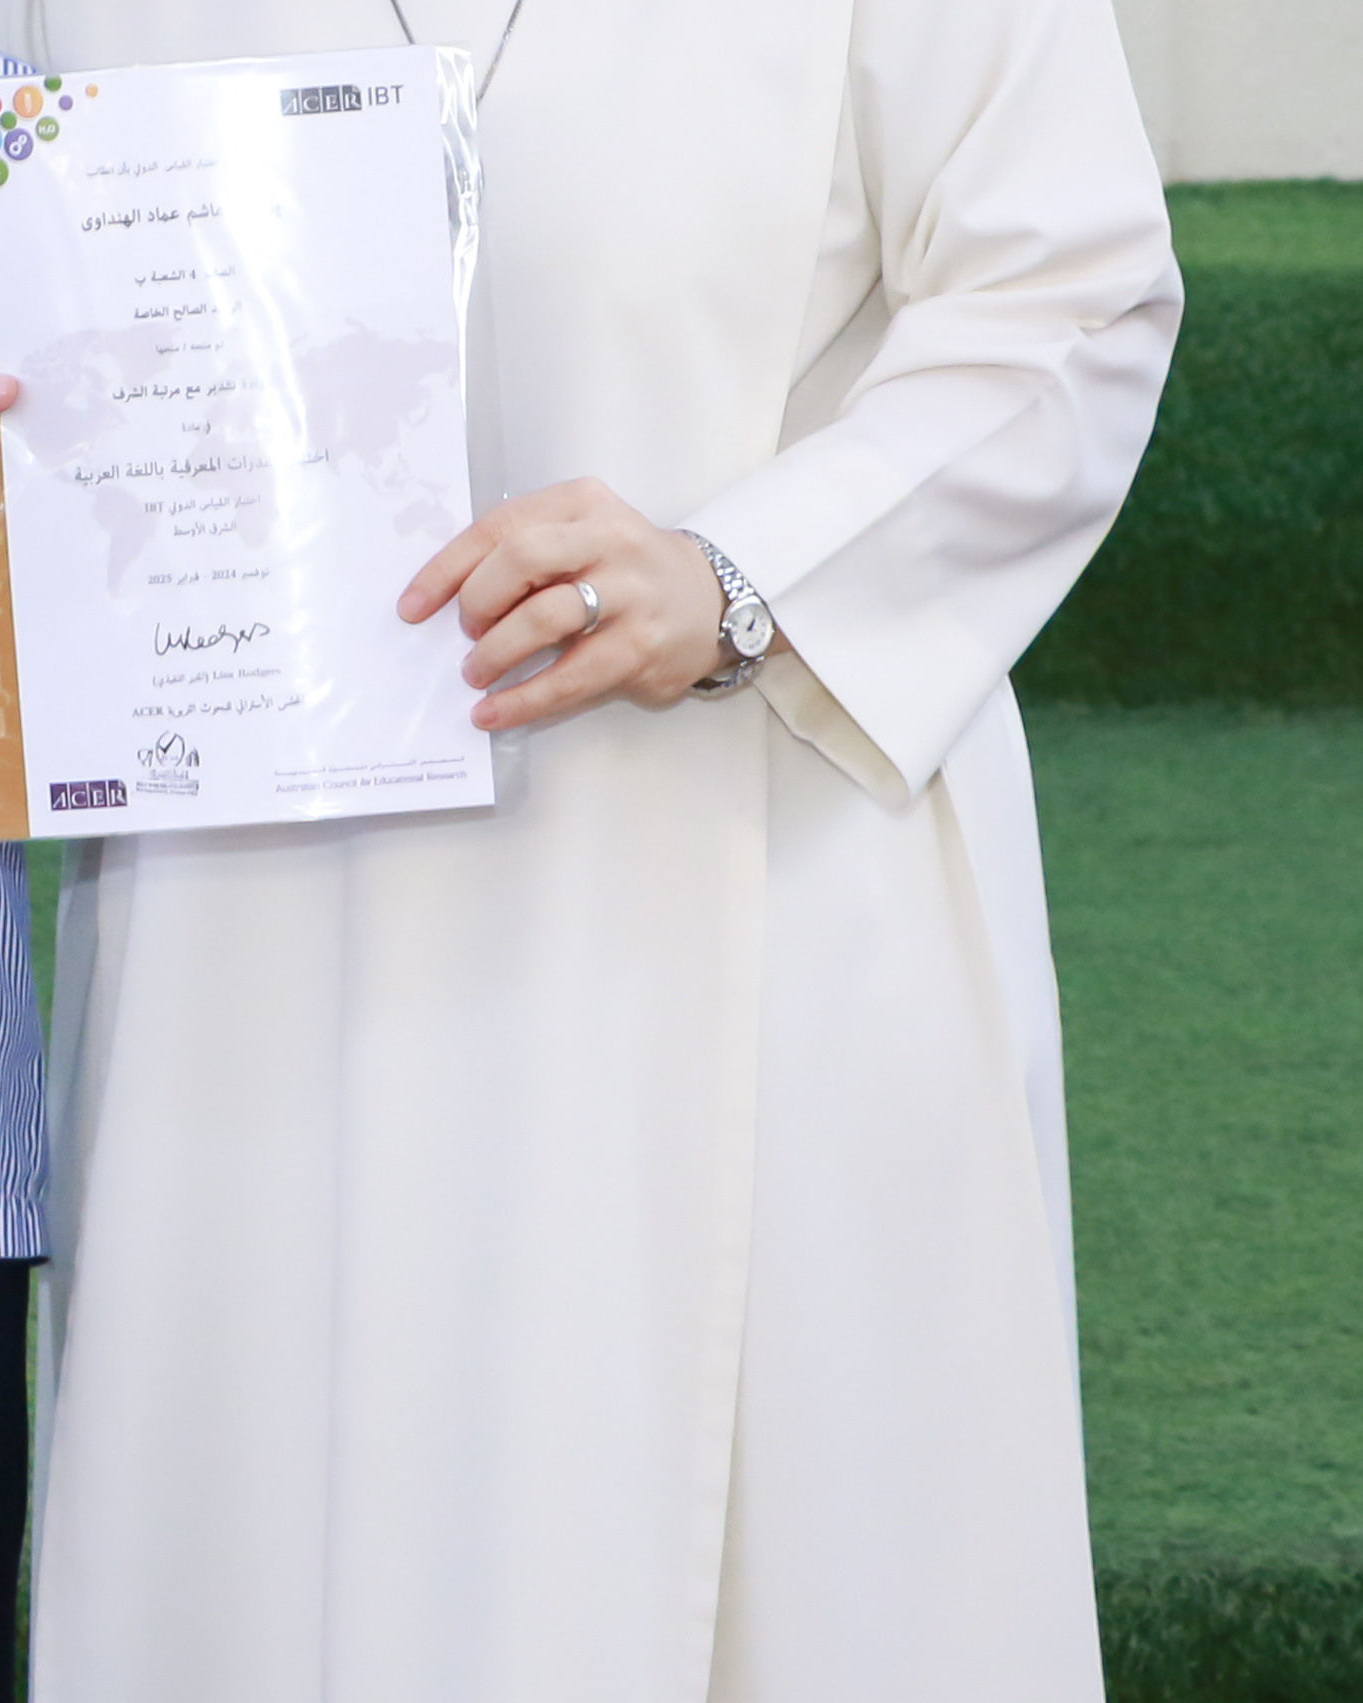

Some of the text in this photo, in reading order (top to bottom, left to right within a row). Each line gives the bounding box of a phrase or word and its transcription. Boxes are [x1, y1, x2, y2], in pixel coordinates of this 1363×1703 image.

[282, 84, 403, 115] ACER IBT
[147, 207, 180, 223] عماد
[188, 269, 196, 279] 4
[134, 306, 170, 320] الخاصة
[173, 303, 207, 321] الصالح
[112, 385, 148, 403] الشرف
[152, 384, 181, 401] مرتبة
[184, 384, 201, 400] مع
[74, 465, 120, 487] العربية
[125, 461, 165, 481] باللغة
[169, 456, 221, 480] المعرفية
[144, 502, 164, 514] IBT
[168, 499, 196, 516] الدولي
[147, 573, 173, 585] 2025
[211, 568, 237, 581] 2024
[52, 786, 126, 809] ACER
